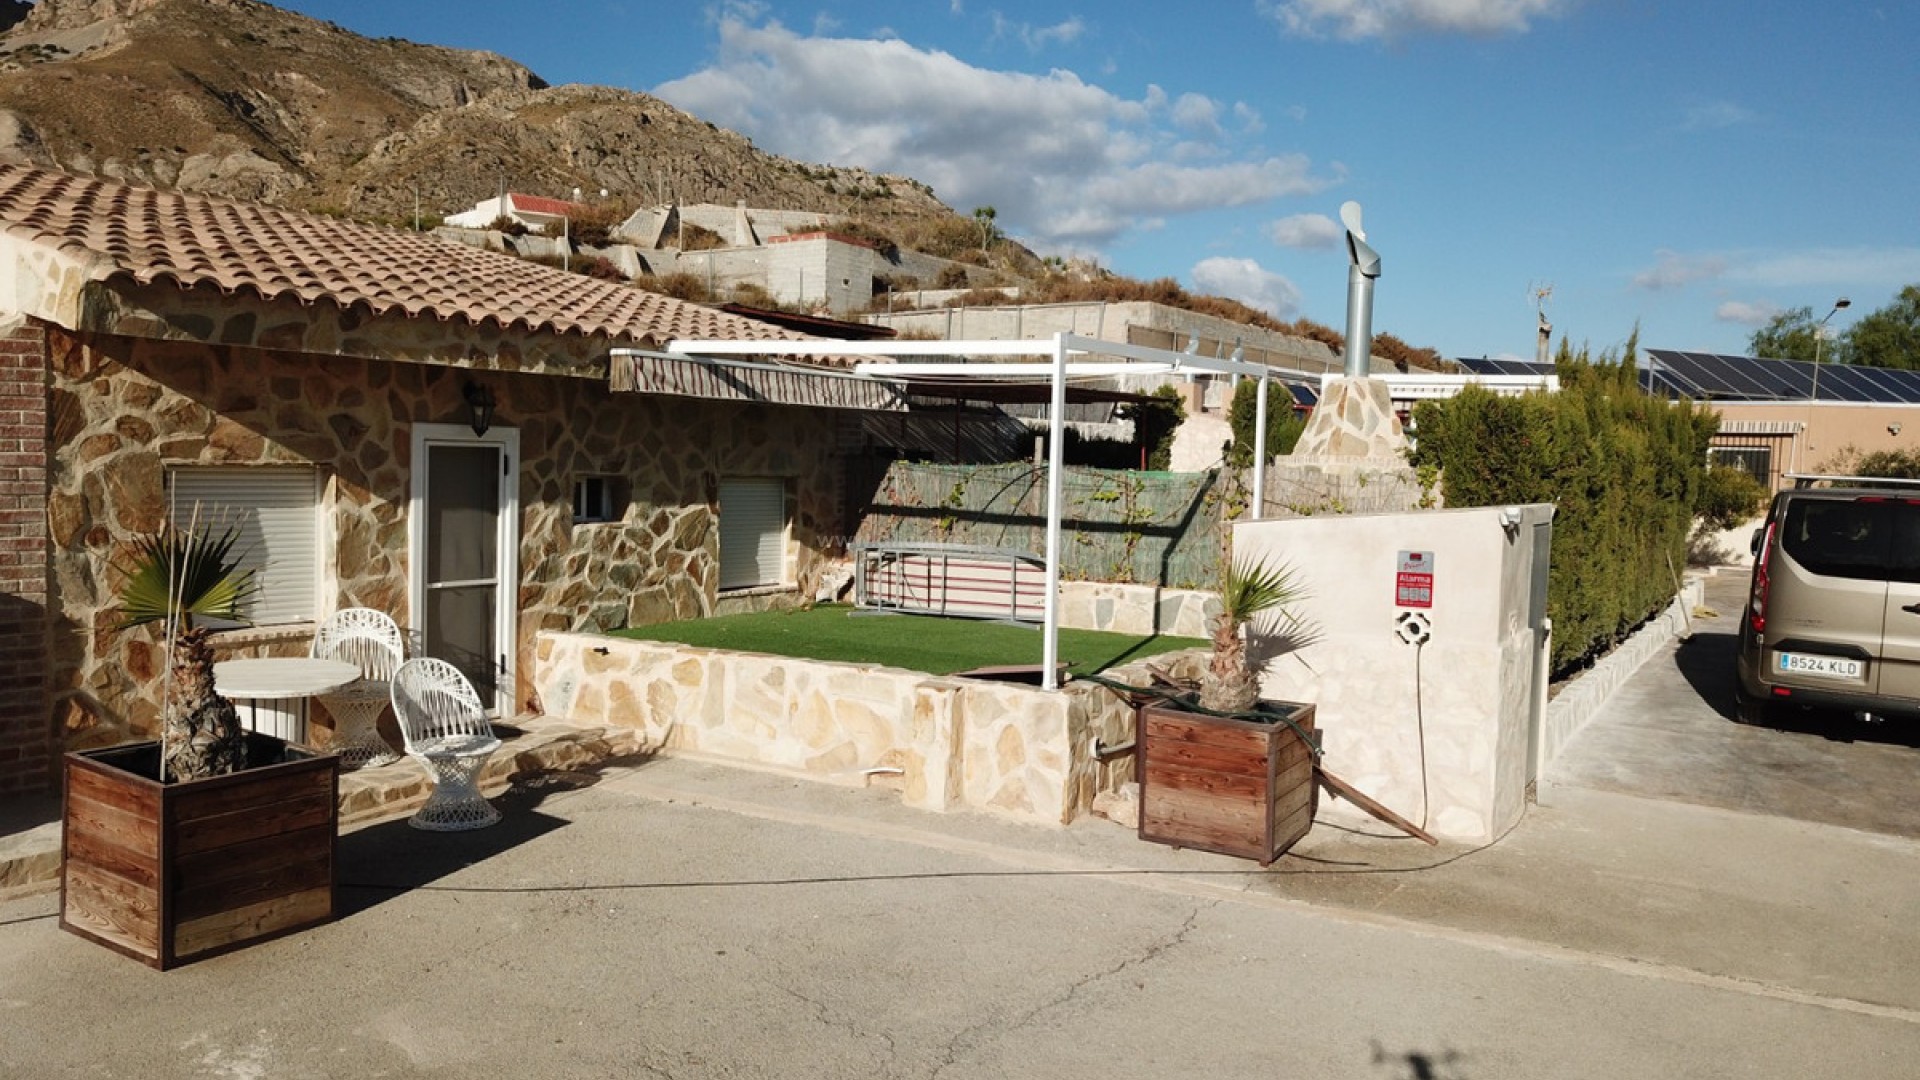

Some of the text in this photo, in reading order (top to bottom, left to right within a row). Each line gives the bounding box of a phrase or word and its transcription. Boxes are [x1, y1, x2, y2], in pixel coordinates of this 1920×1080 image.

[1399, 574, 1431, 583] Alarma
[1790, 656, 1857, 675] 8524 KLD
